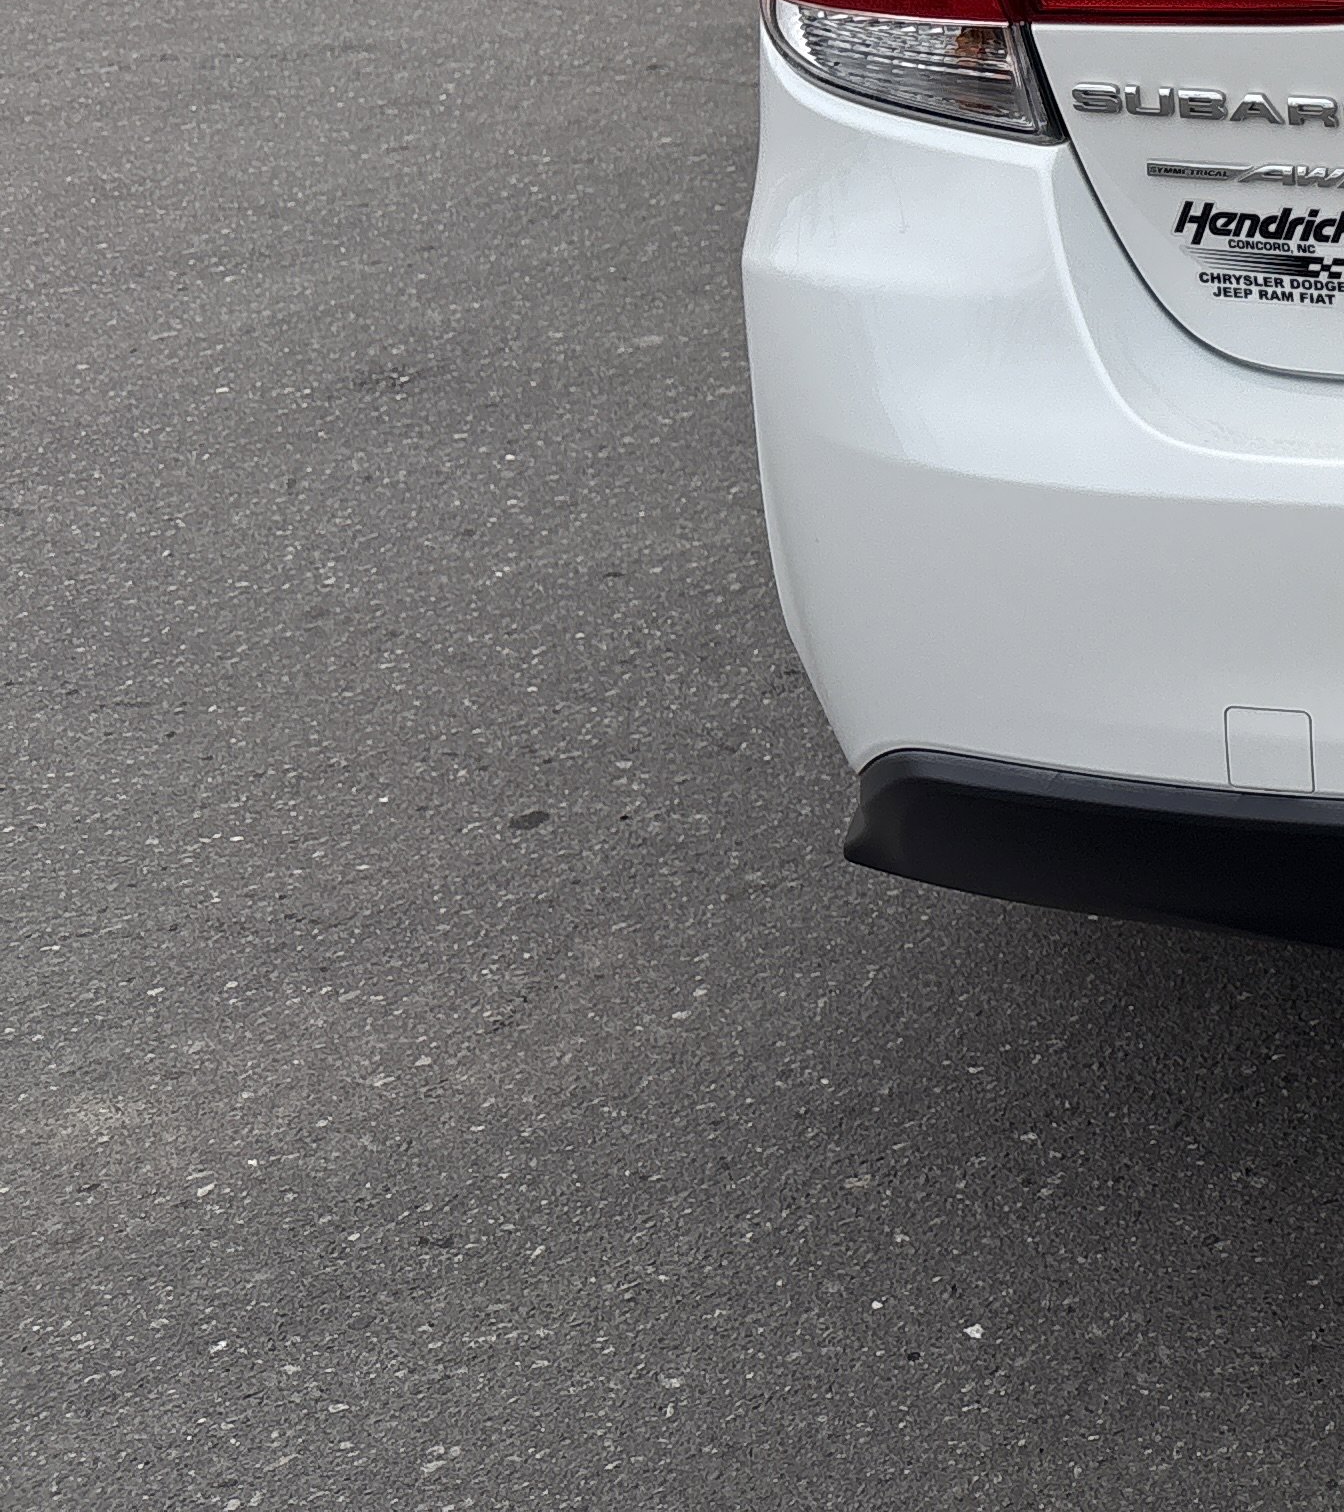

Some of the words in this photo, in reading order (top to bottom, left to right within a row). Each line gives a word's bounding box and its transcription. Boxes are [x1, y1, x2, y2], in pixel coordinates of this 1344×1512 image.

[1228, 238, 1294, 255] CONCORD,
[1296, 243, 1316, 254] NC
[1198, 272, 1286, 289] CHRYSLER
[1213, 286, 1254, 300] JEEP
[1258, 290, 1295, 303] RAM
[1299, 293, 1336, 306] FIAT
